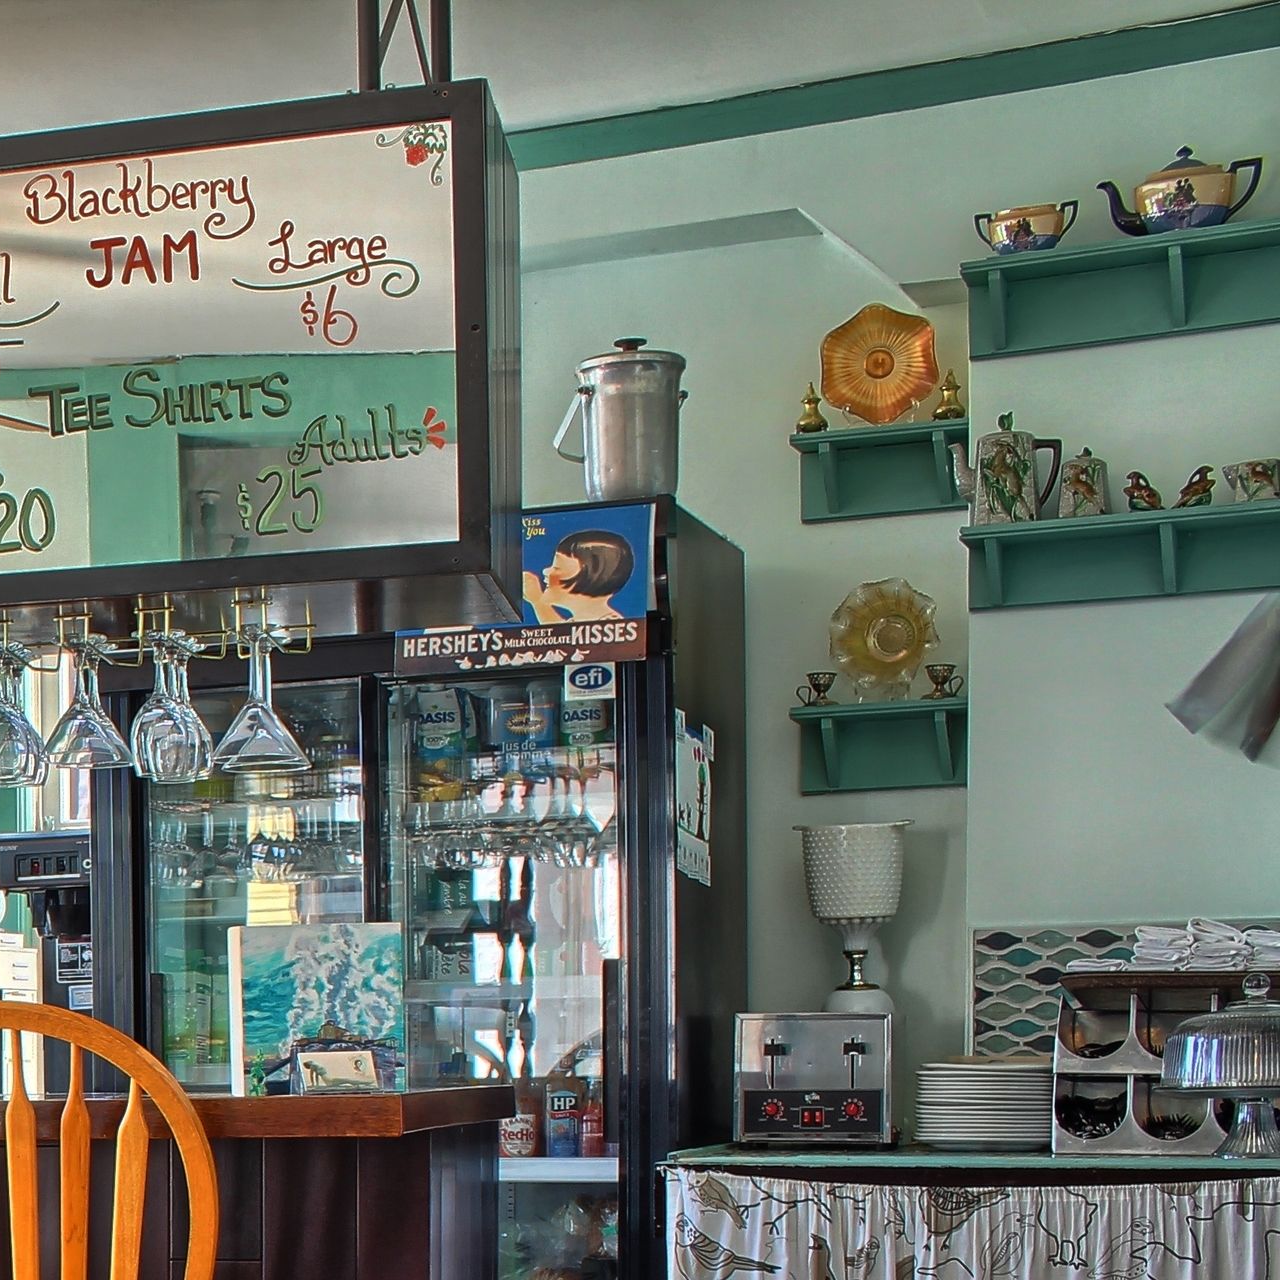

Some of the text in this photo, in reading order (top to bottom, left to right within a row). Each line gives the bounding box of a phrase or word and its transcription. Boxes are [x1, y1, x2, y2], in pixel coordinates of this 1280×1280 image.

[24, 158, 256, 238] Blackberry
[86, 229, 201, 289] JAM
[268, 220, 388, 286] Large
[300, 285, 359, 347] $6
[28, 368, 292, 438] TEE SHIRTS
[288, 403, 427, 467] Adults
[237, 464, 325, 538] $25
[403, 621, 638, 657] HERSHEY'S KISSES
[521, 628, 554, 638] SWEET
[574, 668, 604, 686] efi
[419, 711, 456, 724] OASIS
[563, 709, 601, 722] OASIS
[521, 740, 537, 751] de
[553, 1097, 576, 1110] HP
